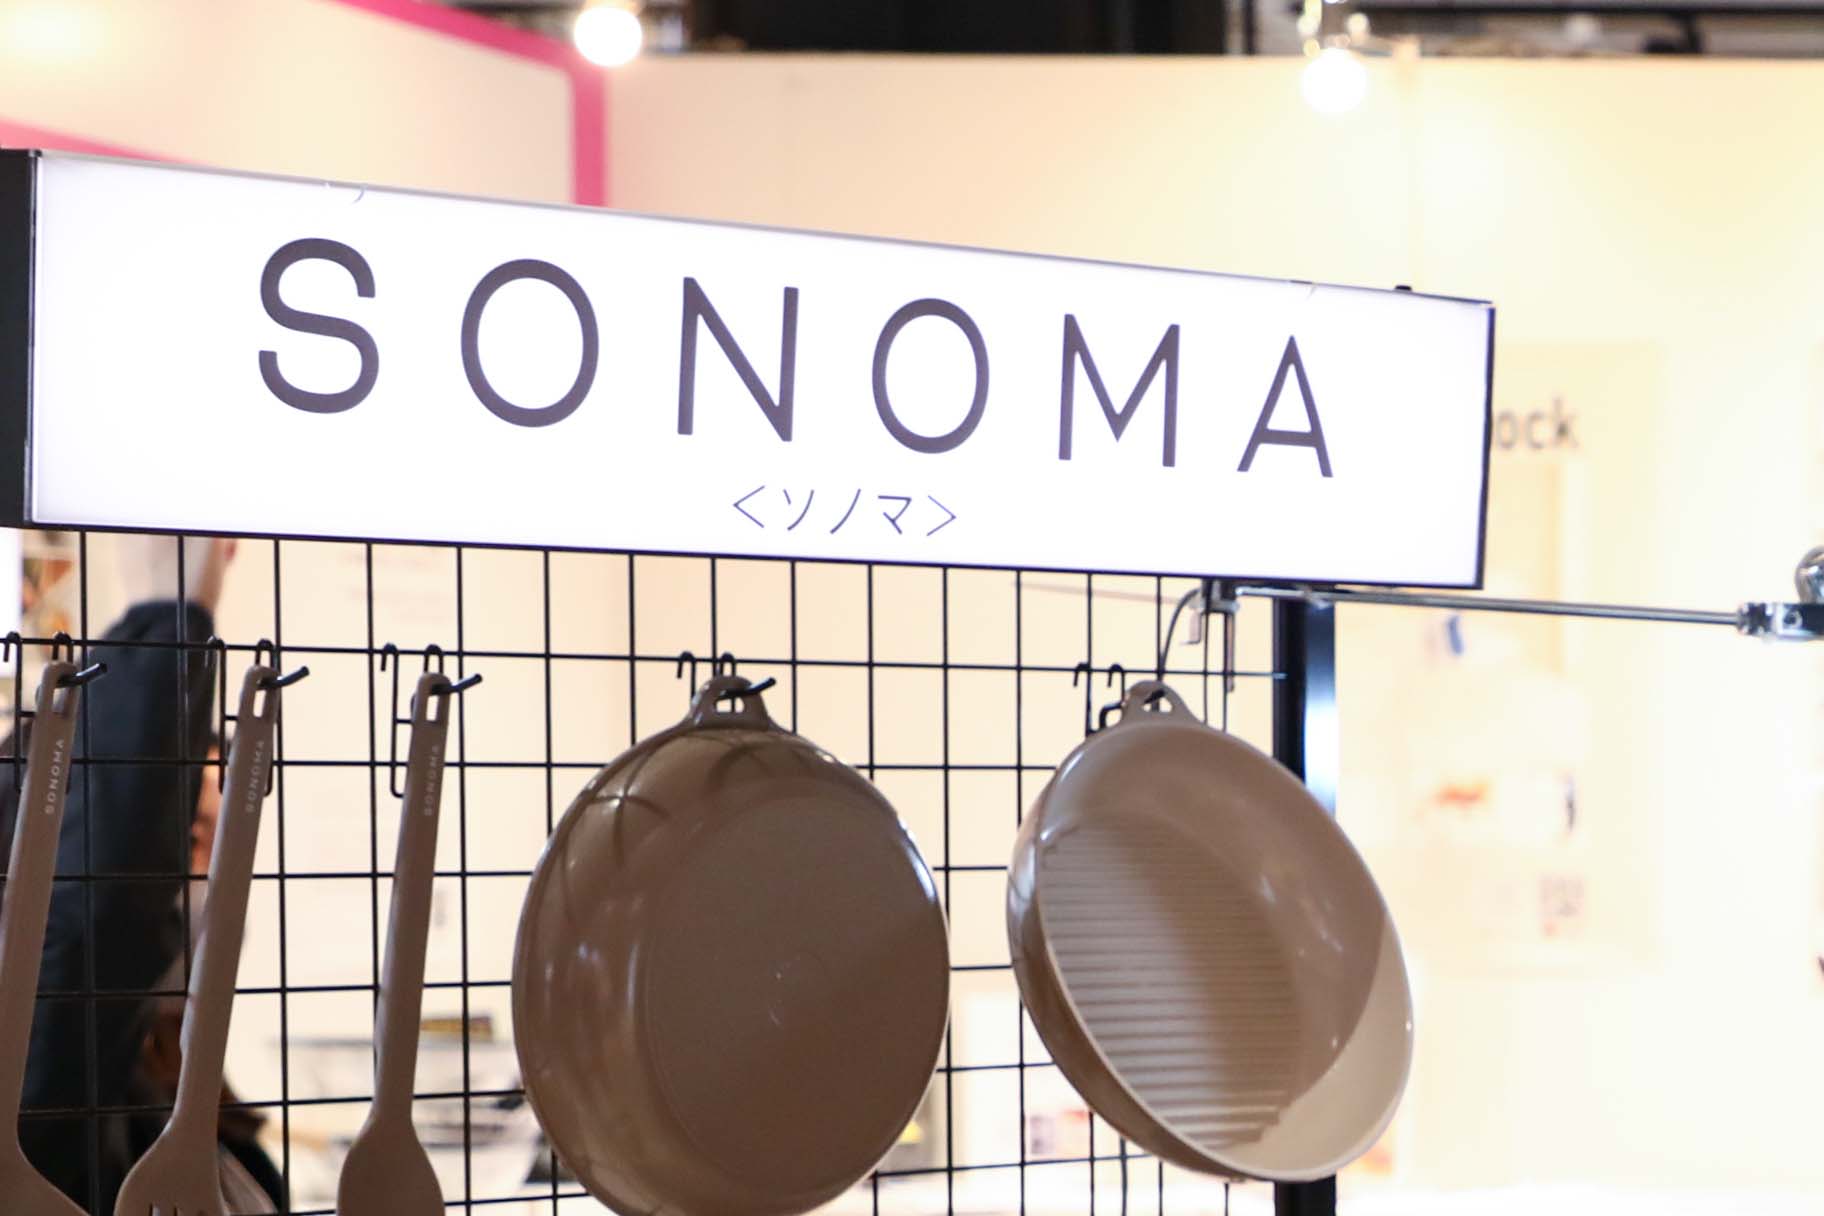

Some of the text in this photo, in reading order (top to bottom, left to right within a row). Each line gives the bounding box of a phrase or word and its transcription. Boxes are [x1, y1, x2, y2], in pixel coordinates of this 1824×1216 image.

[258, 237, 1334, 479] SONOMA
[44, 738, 66, 815] SONOMA
[244, 740, 266, 814] SONOMA
[423, 745, 441, 817] SONOMA
